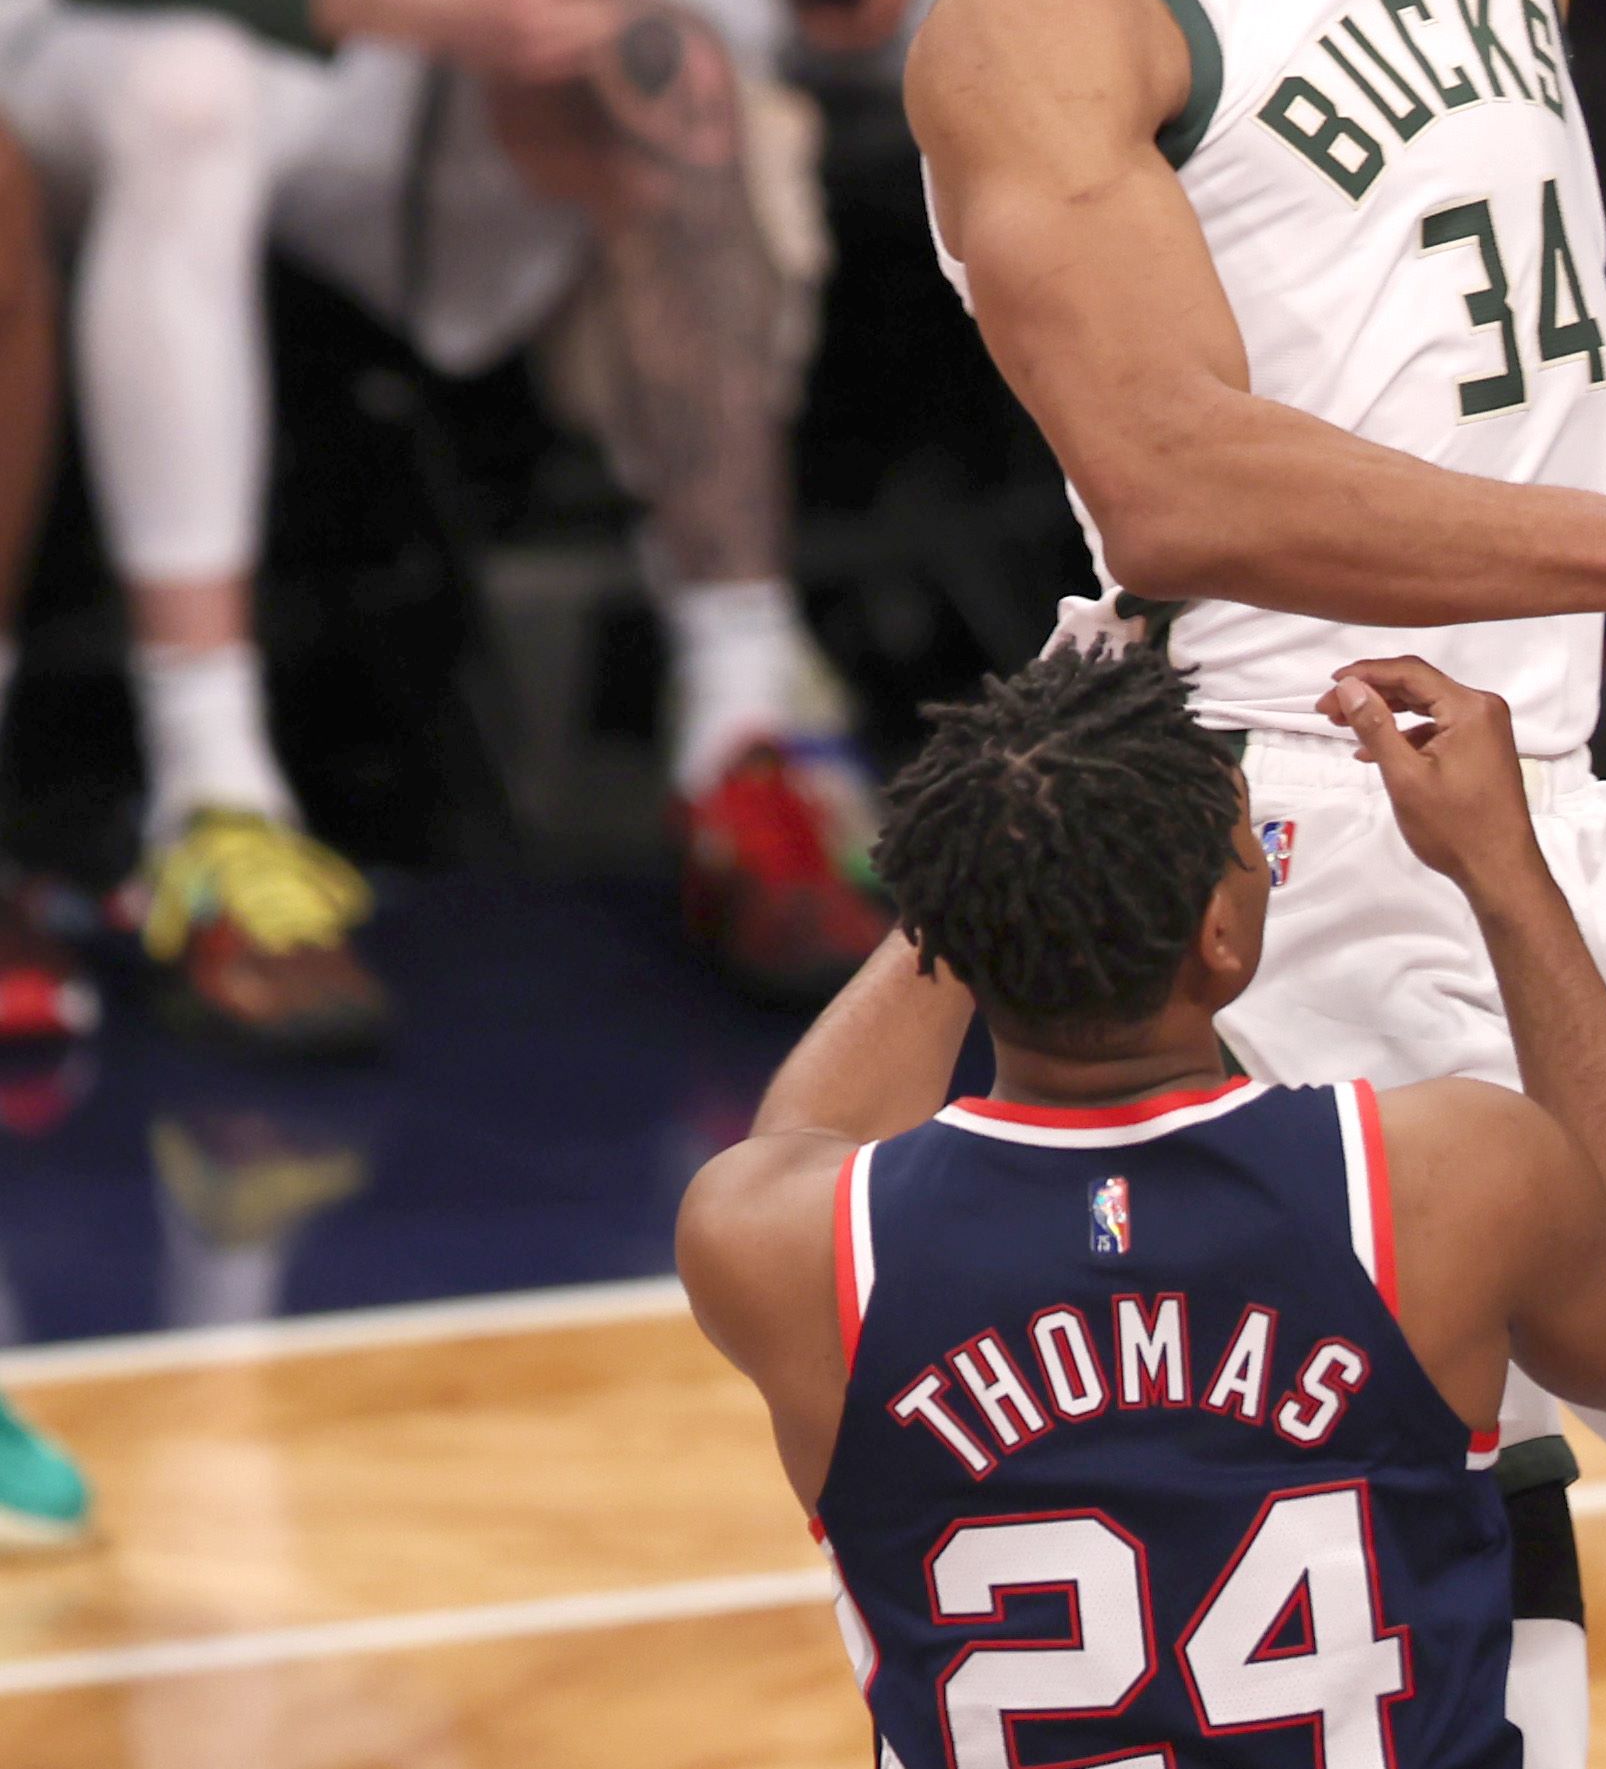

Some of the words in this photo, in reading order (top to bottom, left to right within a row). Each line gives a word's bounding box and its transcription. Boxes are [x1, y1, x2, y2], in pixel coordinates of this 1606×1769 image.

[1418, 180, 1606, 422] 34
[888, 1292, 1368, 1479] THOMAS
[924, 1480, 1414, 1769] 24
